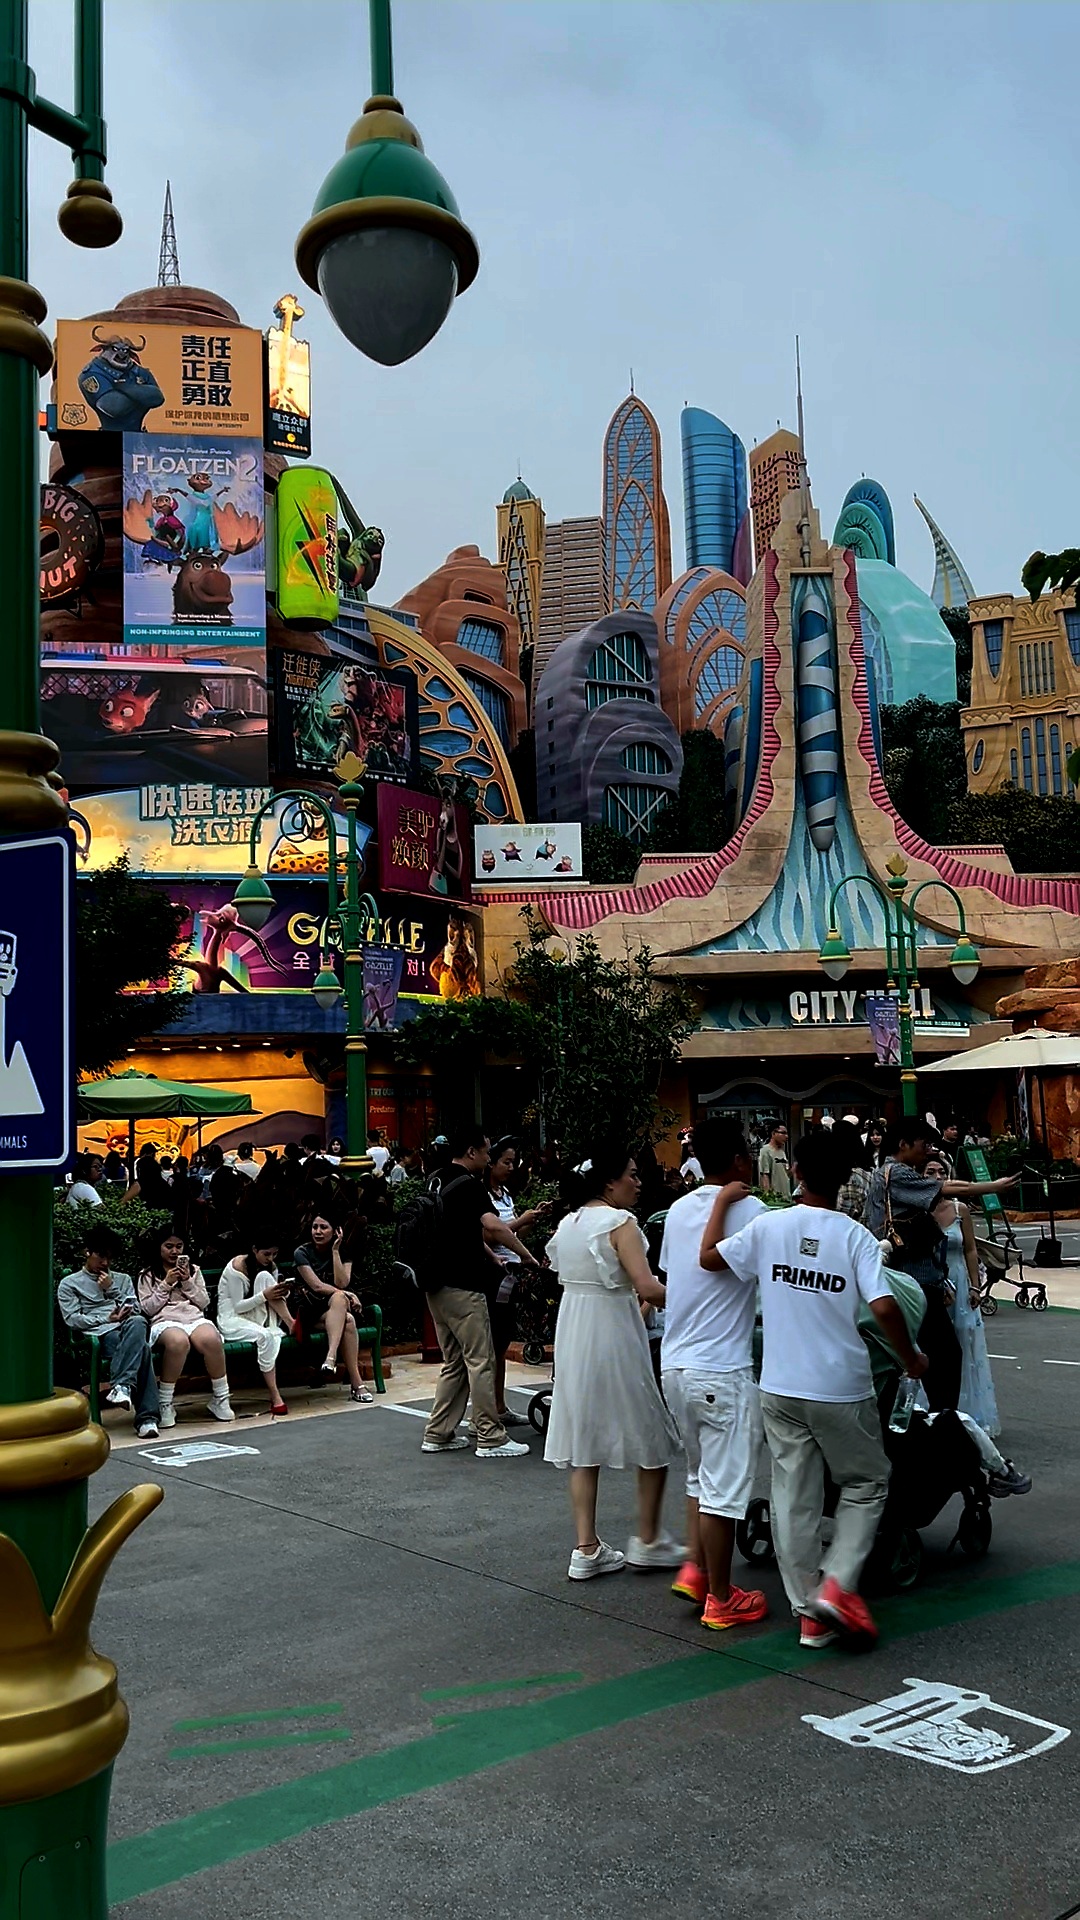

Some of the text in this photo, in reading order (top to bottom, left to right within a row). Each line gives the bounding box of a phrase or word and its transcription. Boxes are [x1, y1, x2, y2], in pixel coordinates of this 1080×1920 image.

[182, 335, 231, 359] 责任
[182, 359, 231, 383] 正直
[182, 383, 232, 406] 勇敢
[132, 454, 240, 476] FLOATZEN
[44, 490, 79, 523] BIG
[130, 628, 261, 638] NON-INFRINGING ENTERTAINMENT
[282, 652, 321, 678] 迁徙侠
[141, 783, 271, 817] 快速祛斑
[399, 803, 434, 838] 美驴
[392, 835, 429, 871] 焕颜
[789, 990, 857, 1021] CITY
[772, 1264, 847, 1294] FRIMND
